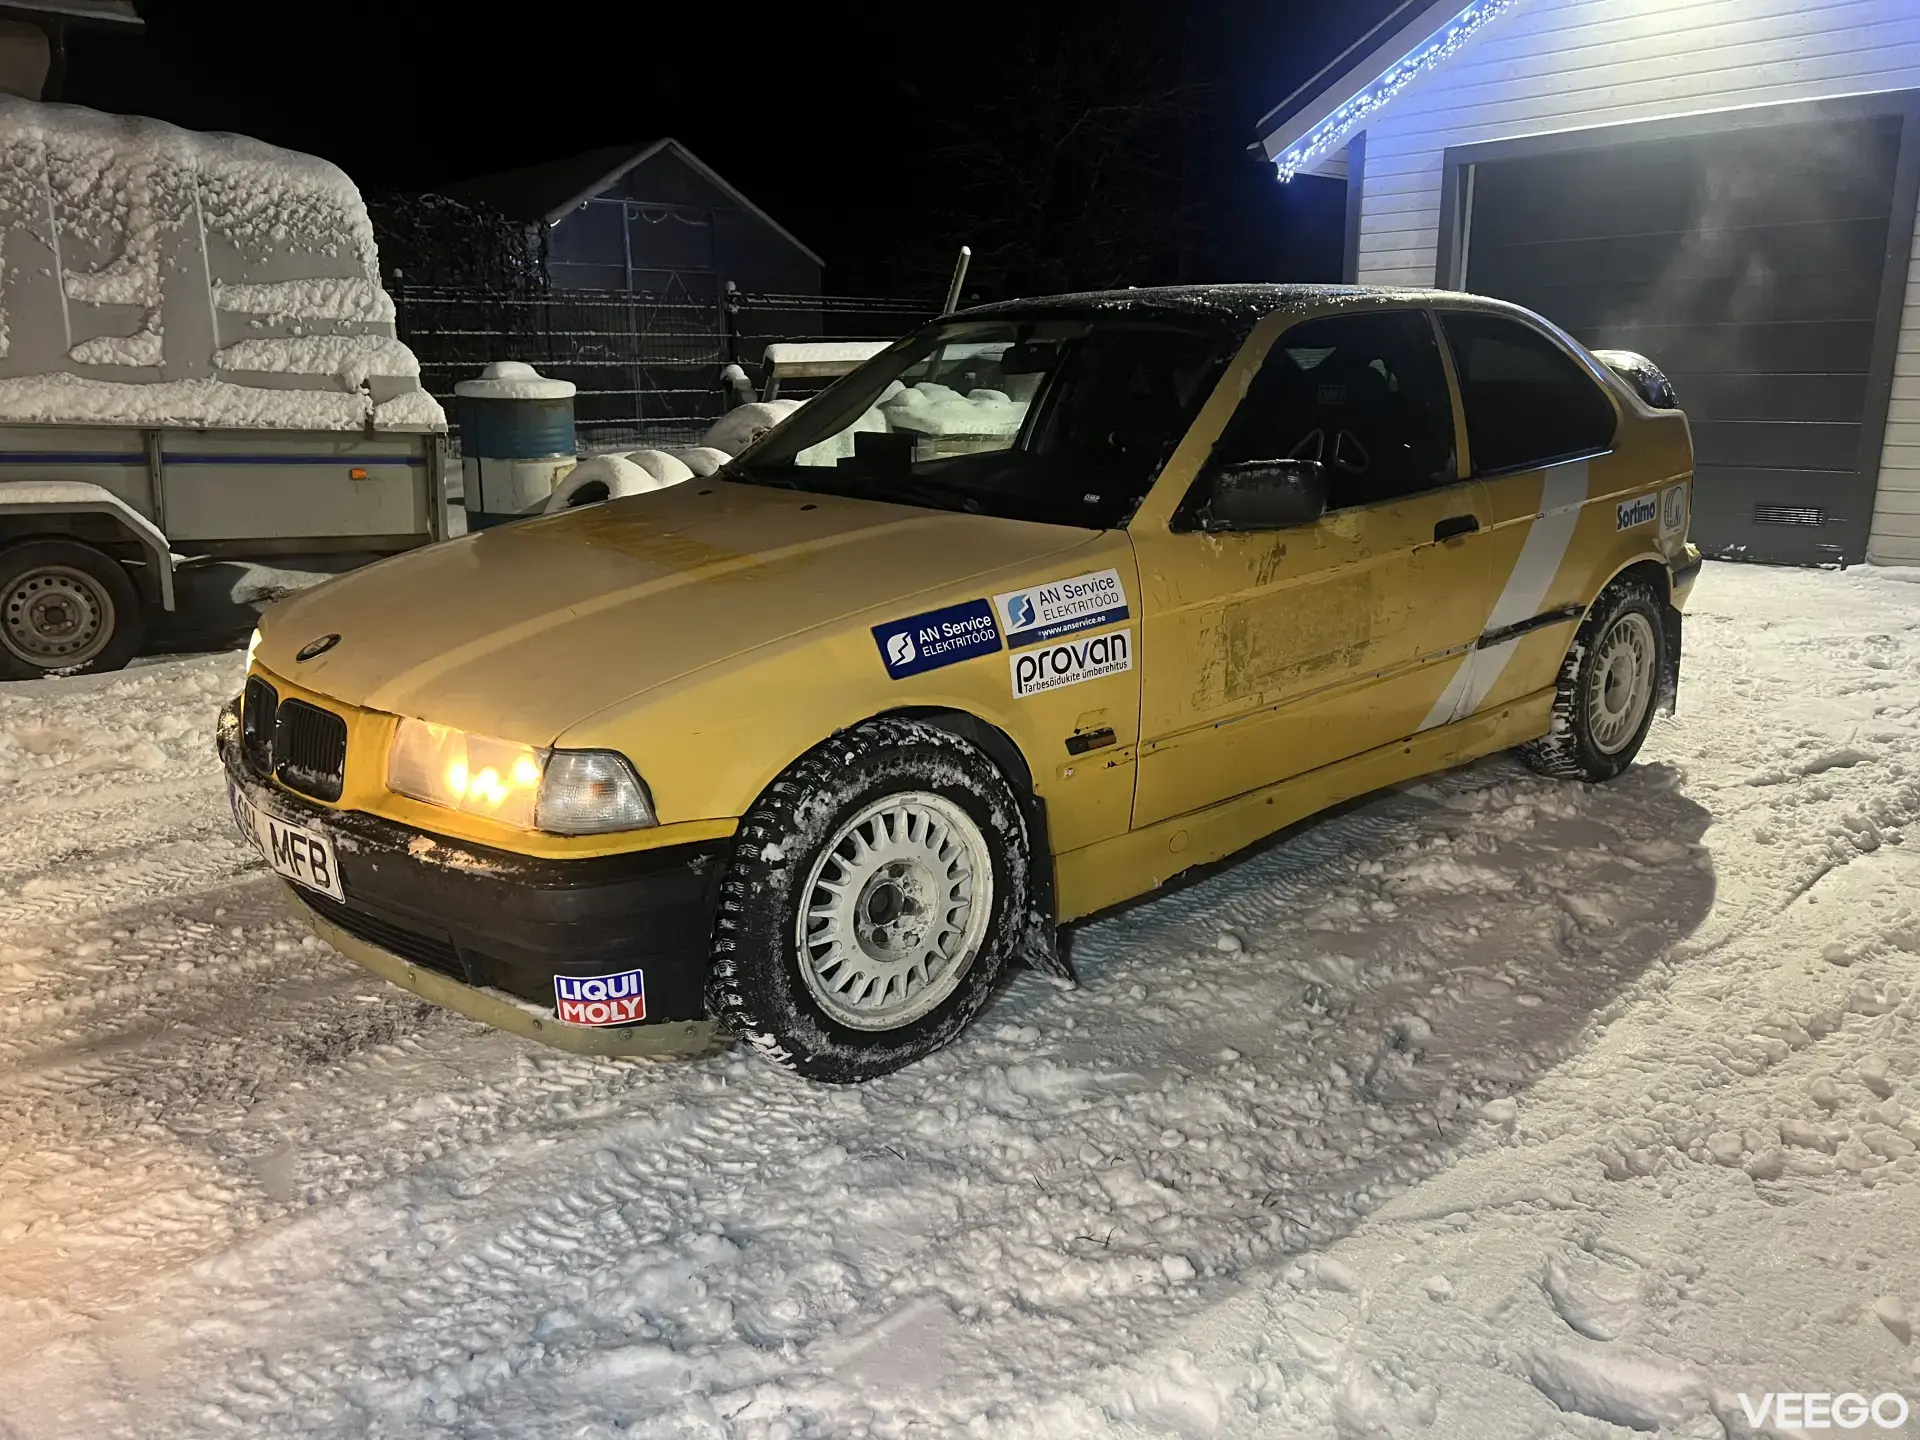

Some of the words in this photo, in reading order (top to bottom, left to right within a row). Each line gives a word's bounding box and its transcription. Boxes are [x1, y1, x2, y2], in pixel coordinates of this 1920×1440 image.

[1617, 500, 1656, 530] Sortimo
[1039, 587, 1061, 606] AN
[1063, 577, 1115, 600] Service
[919, 626, 941, 644] AN
[942, 616, 992, 637] Service
[1041, 615, 1106, 637] www.anservice.ee
[1016, 634, 1127, 694] provan
[1023, 673, 1081, 693] Tarbesõidukite
[1082, 660, 1128, 679] ümberehitus
[269, 822, 331, 889] MFB
[559, 974, 638, 1001] LIQUI
[562, 997, 641, 1023] MOLY
